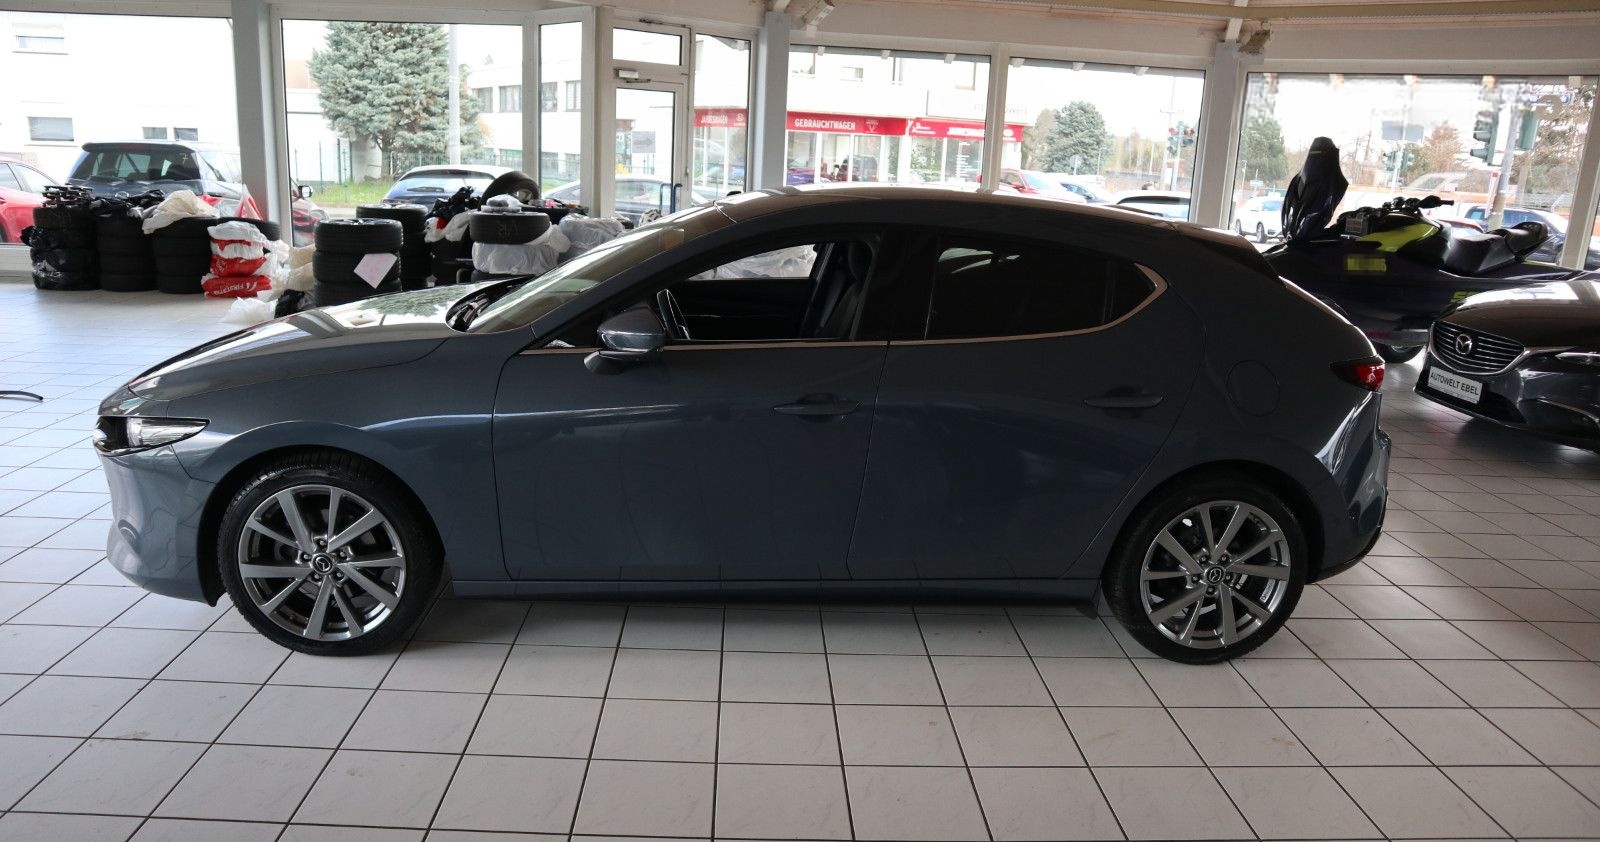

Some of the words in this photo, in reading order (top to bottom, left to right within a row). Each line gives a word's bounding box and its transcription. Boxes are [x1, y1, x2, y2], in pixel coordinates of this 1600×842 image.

[794, 118, 856, 130] GEBRAUCHTWAGEN
[1430, 372, 1461, 388] AUTOWELT
[1460, 382, 1479, 396] EBEL
